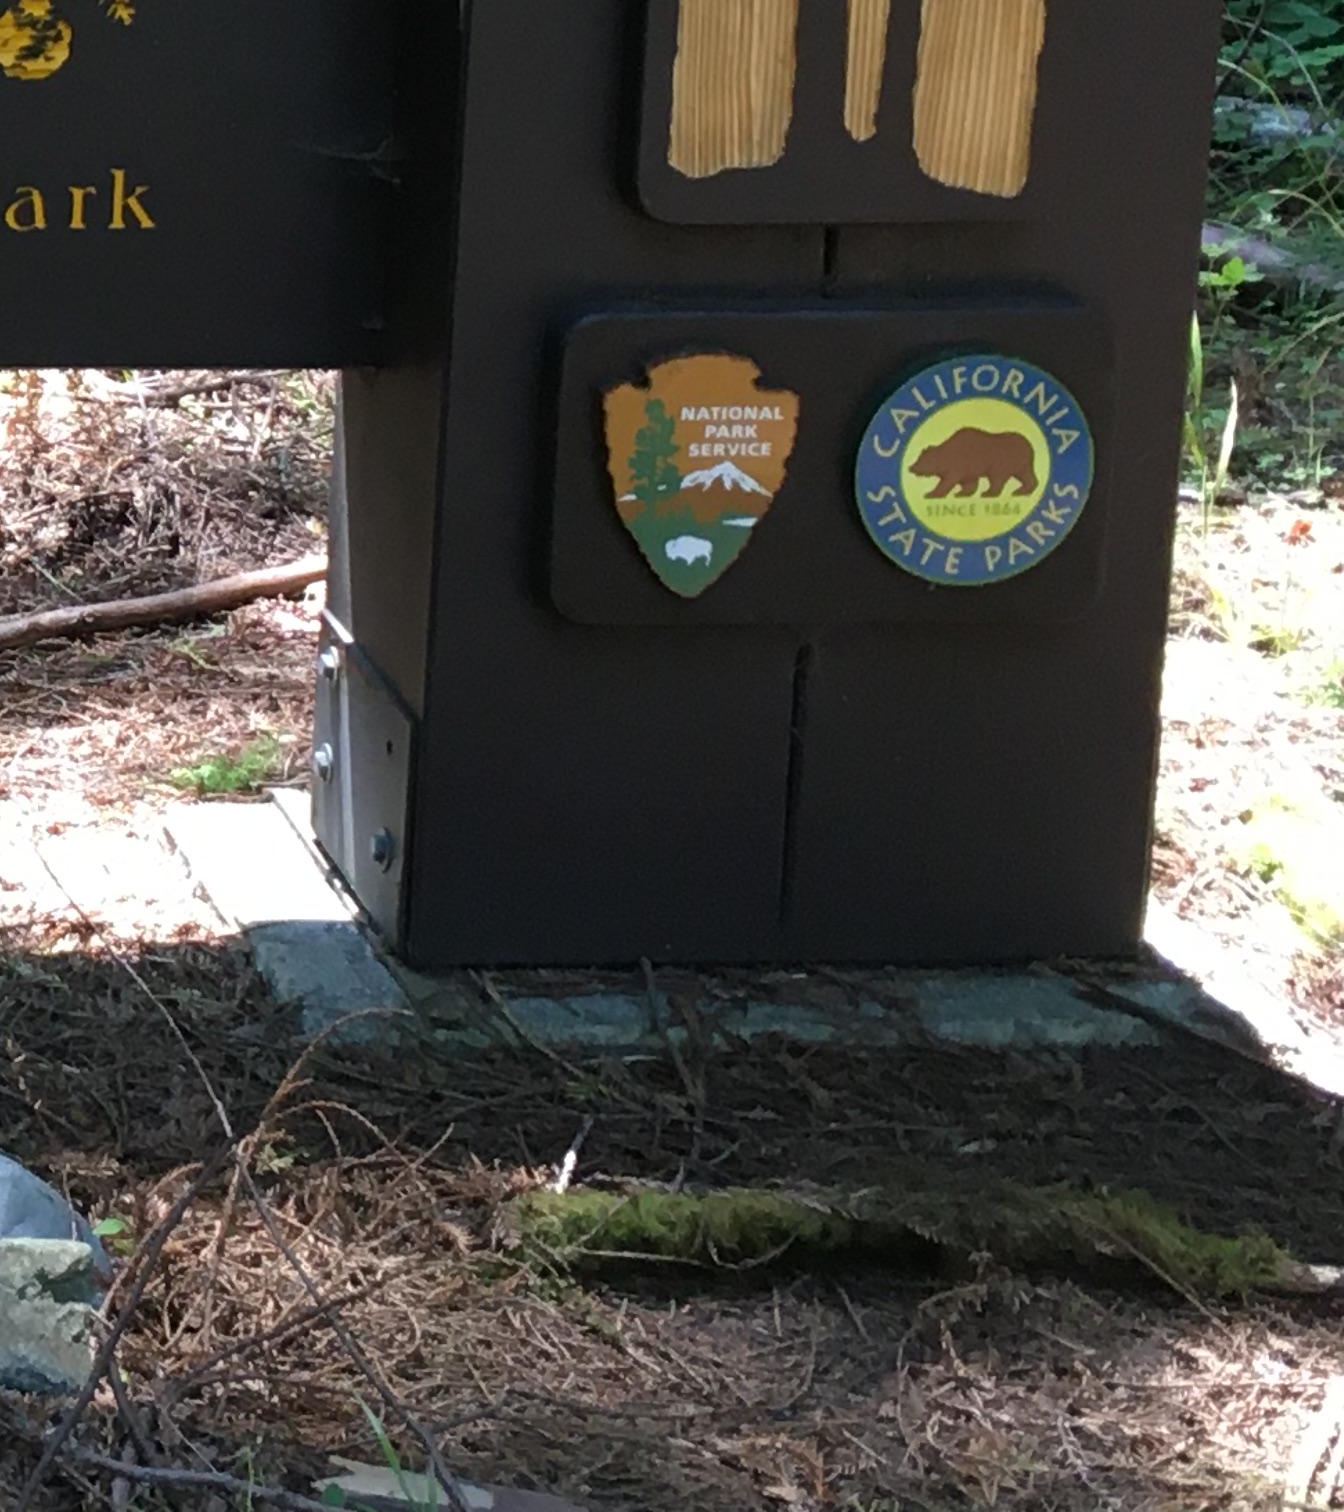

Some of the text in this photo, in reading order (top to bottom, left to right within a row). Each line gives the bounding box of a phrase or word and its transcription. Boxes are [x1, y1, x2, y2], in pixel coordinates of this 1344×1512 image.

[679, 405, 785, 421] NATIONAL
[873, 364, 1081, 458] CALIFORNIA
[703, 424, 758, 439] PARK
[687, 442, 773, 457] SERVICE
[925, 503, 977, 518] SINCE
[866, 483, 1080, 575] STATE PARKS
